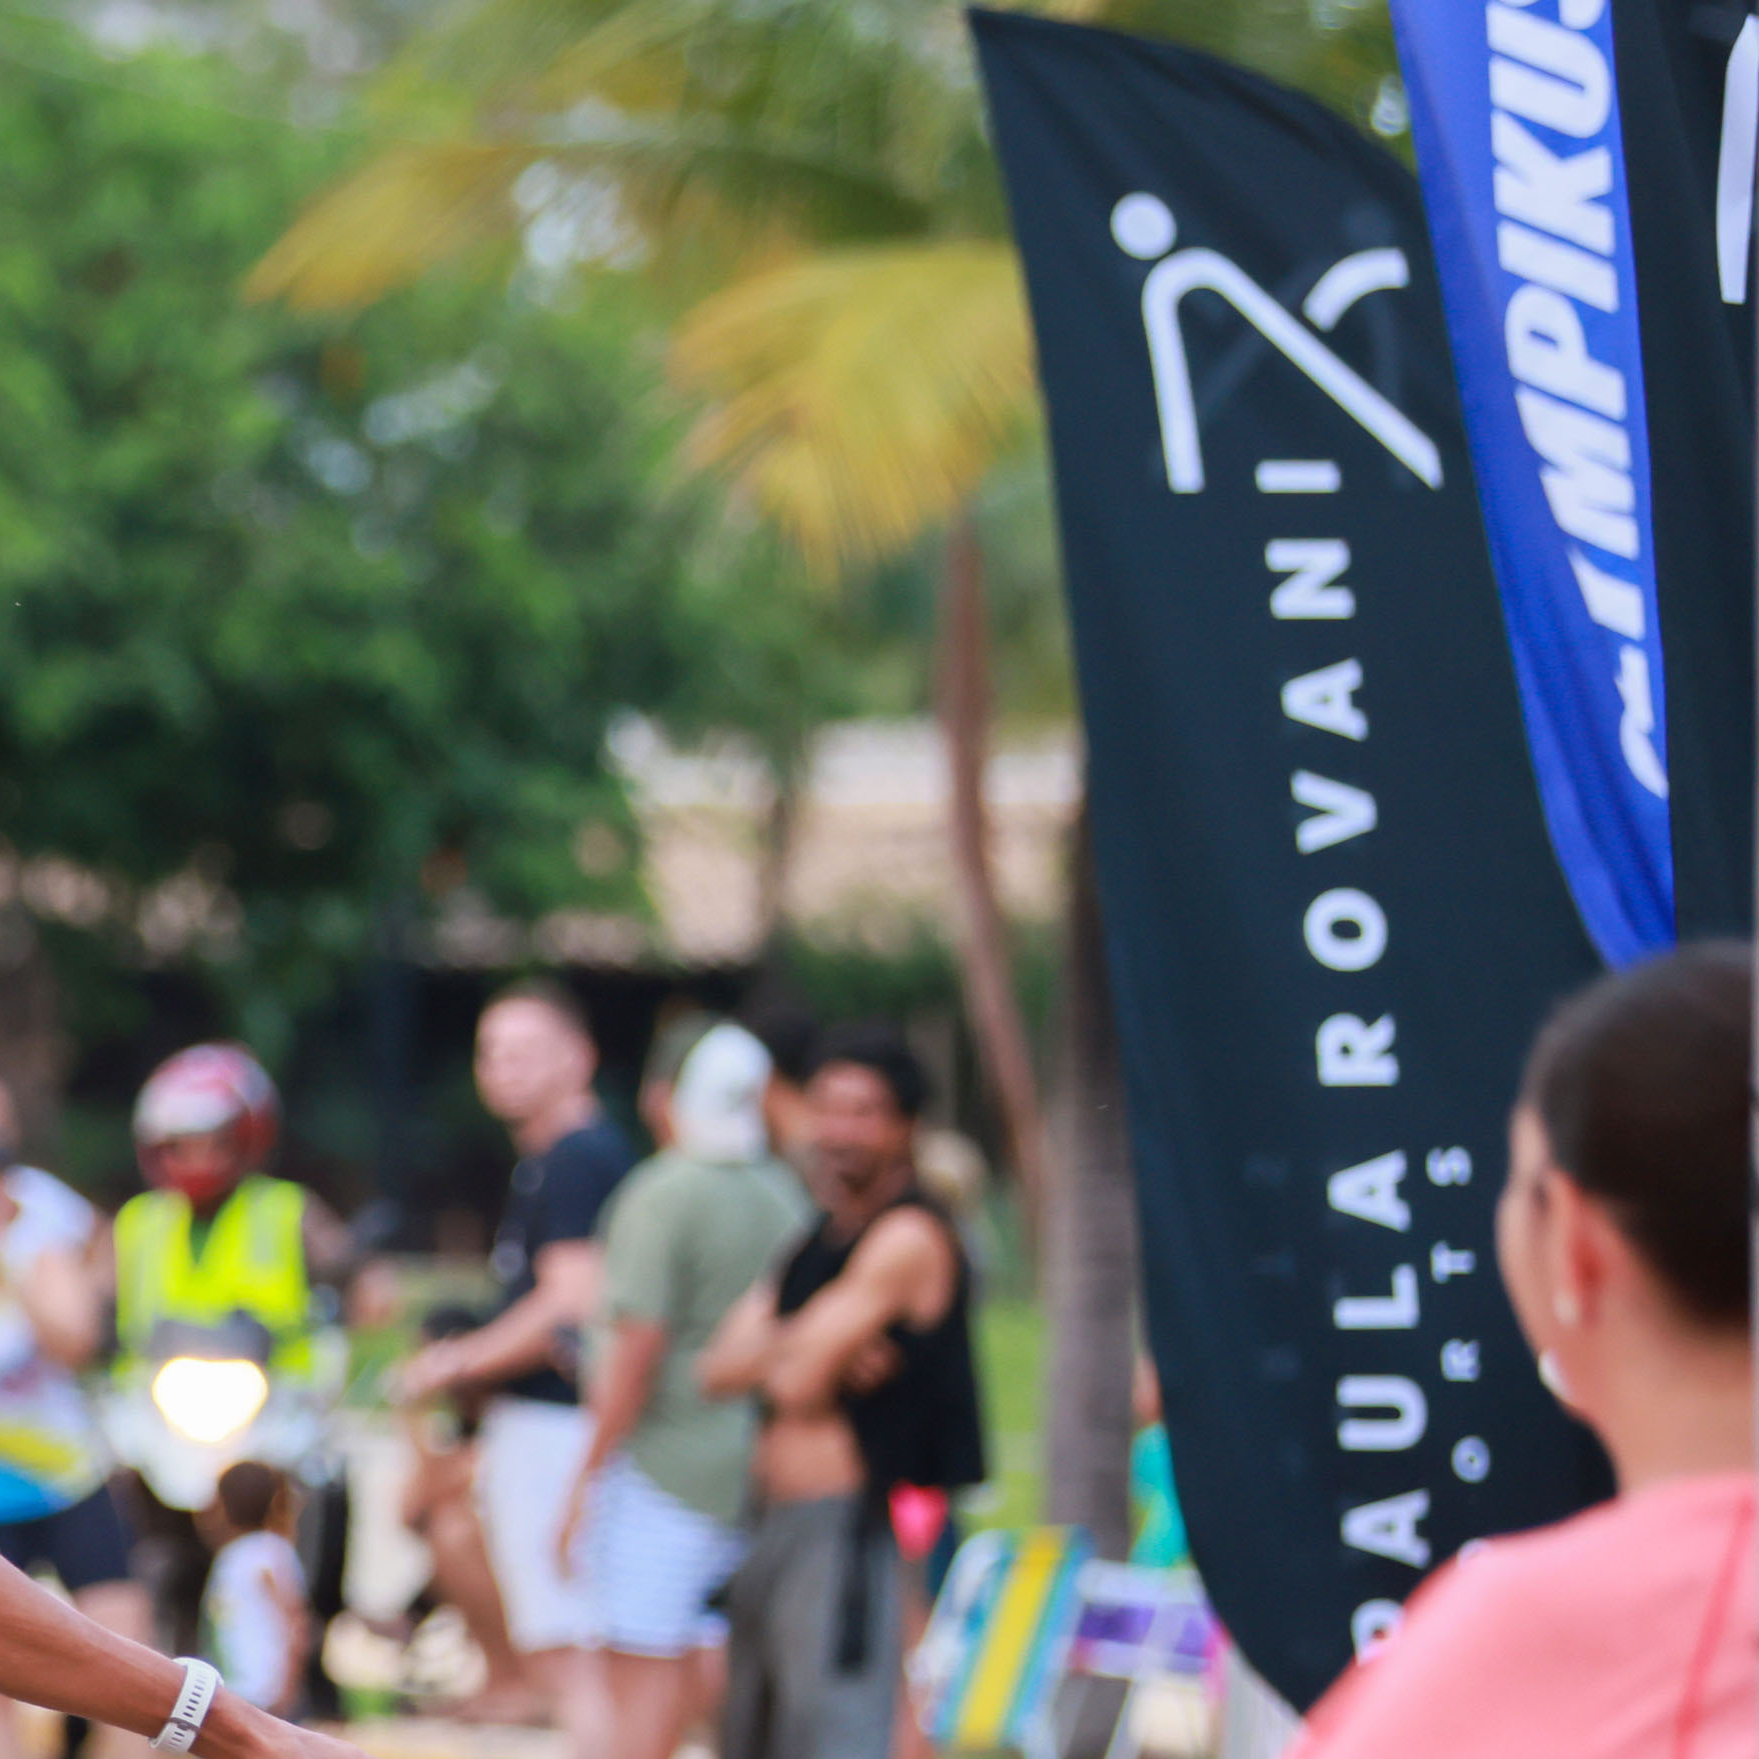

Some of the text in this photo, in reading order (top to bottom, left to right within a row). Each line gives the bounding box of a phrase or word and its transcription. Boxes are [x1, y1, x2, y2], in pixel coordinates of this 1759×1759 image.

[1484, 0, 1669, 800] MPIKU
[1254, 458, 1402, 1089] ROVANI
[1425, 1145, 1492, 1560] ORTS
